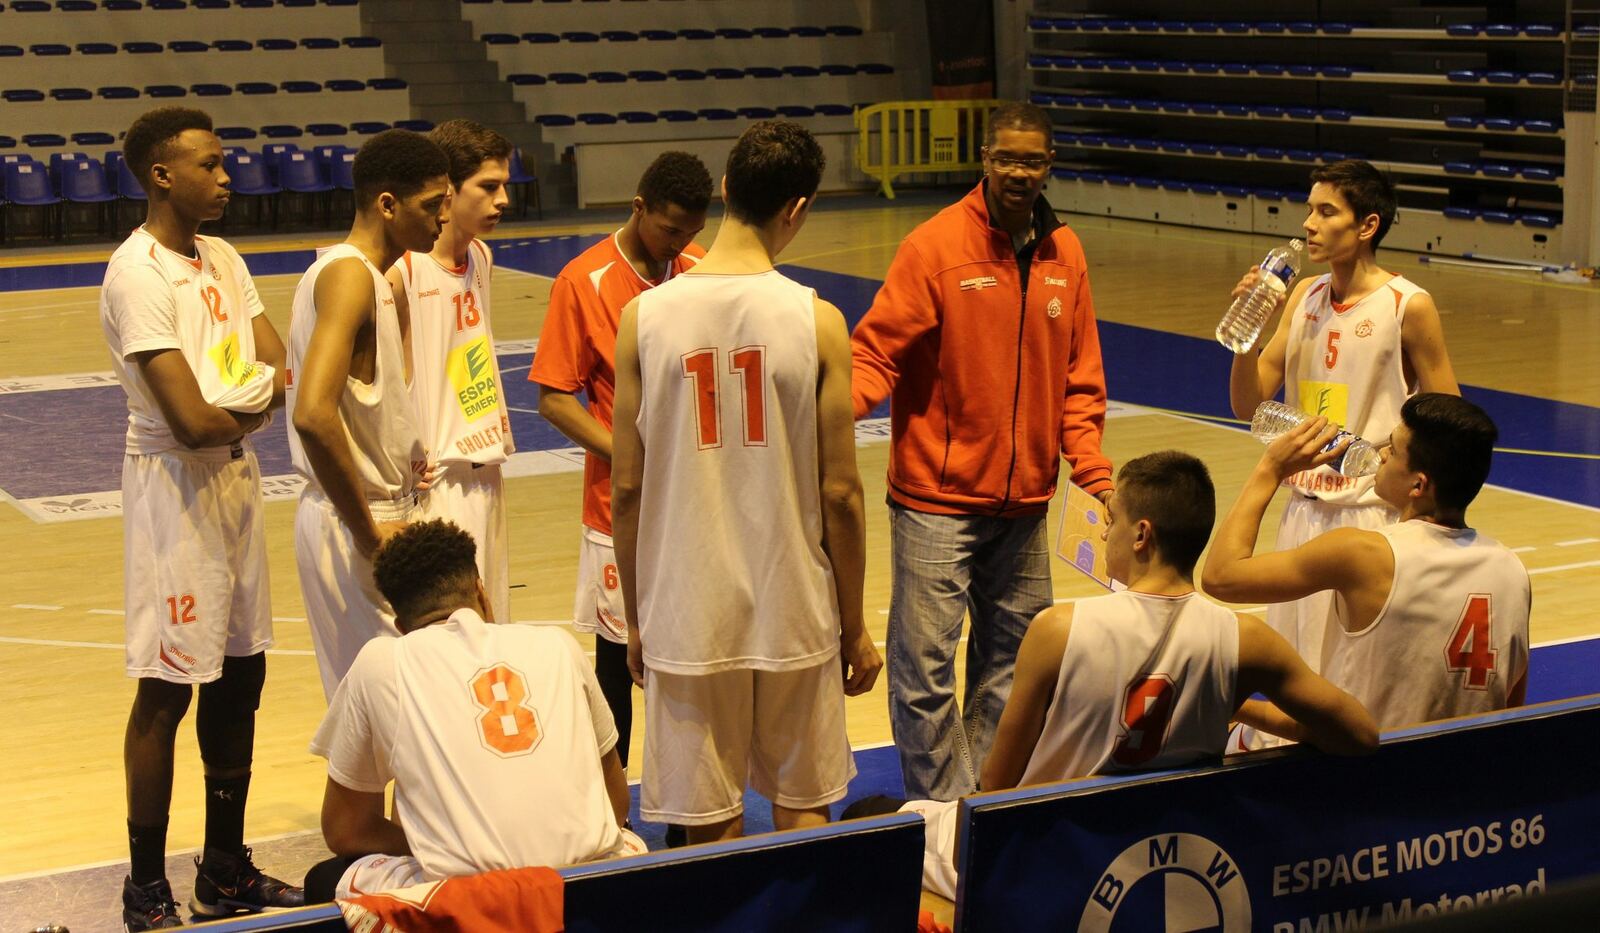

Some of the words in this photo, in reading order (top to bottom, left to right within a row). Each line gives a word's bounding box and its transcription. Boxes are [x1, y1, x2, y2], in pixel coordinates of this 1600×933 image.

[200, 285, 229, 326] 12
[451, 290, 481, 333] 13
[1325, 329, 1342, 371] 5
[680, 345, 768, 451] 11
[166, 594, 197, 626] 12
[603, 564, 618, 590] 6
[1443, 593, 1498, 691] 4
[467, 661, 544, 760] 8
[1109, 672, 1177, 768] 9
[1092, 835, 1239, 913] BMW
[1272, 844, 1389, 897] ESPACE
[1396, 821, 1503, 873] MOTOS
[1510, 814, 1546, 849] 86
